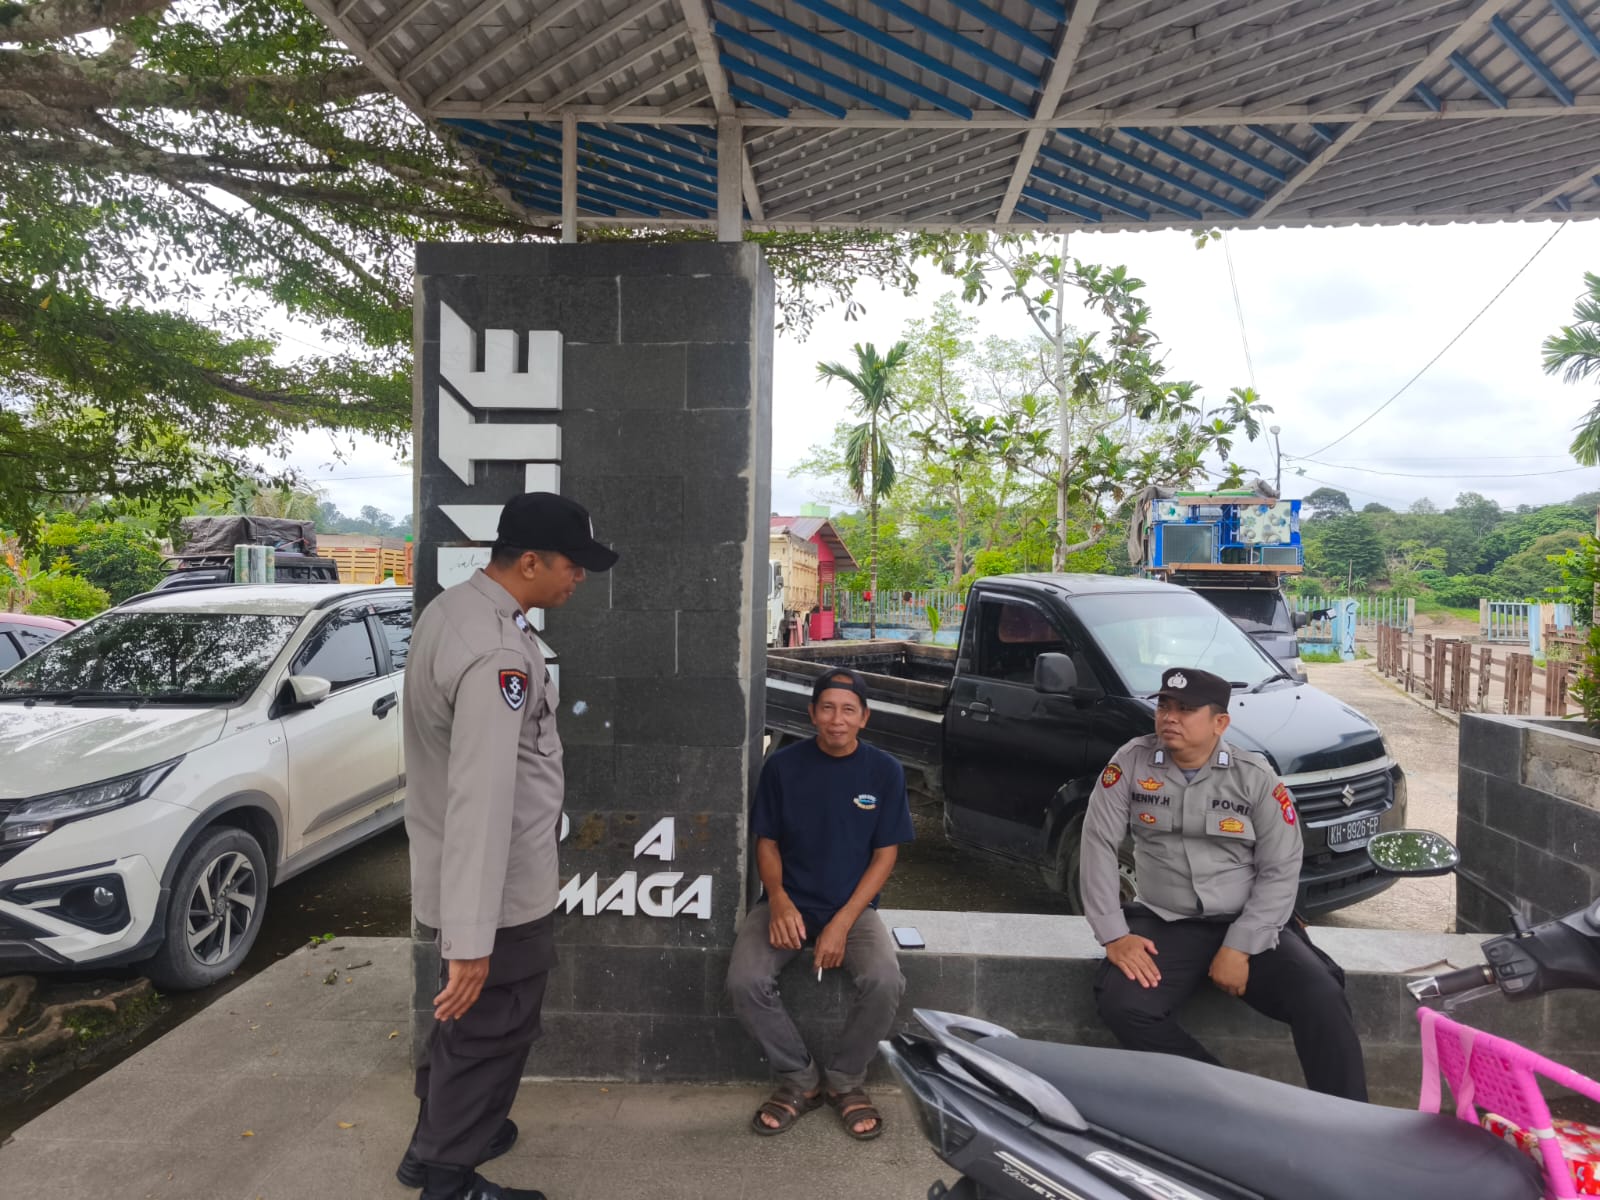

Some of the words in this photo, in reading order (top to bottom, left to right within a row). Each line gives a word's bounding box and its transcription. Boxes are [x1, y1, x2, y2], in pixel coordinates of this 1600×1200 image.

[1211, 799, 1250, 816] POLRI
[1330, 824, 1342, 845] KH
[1346, 819, 1367, 840] 8926
